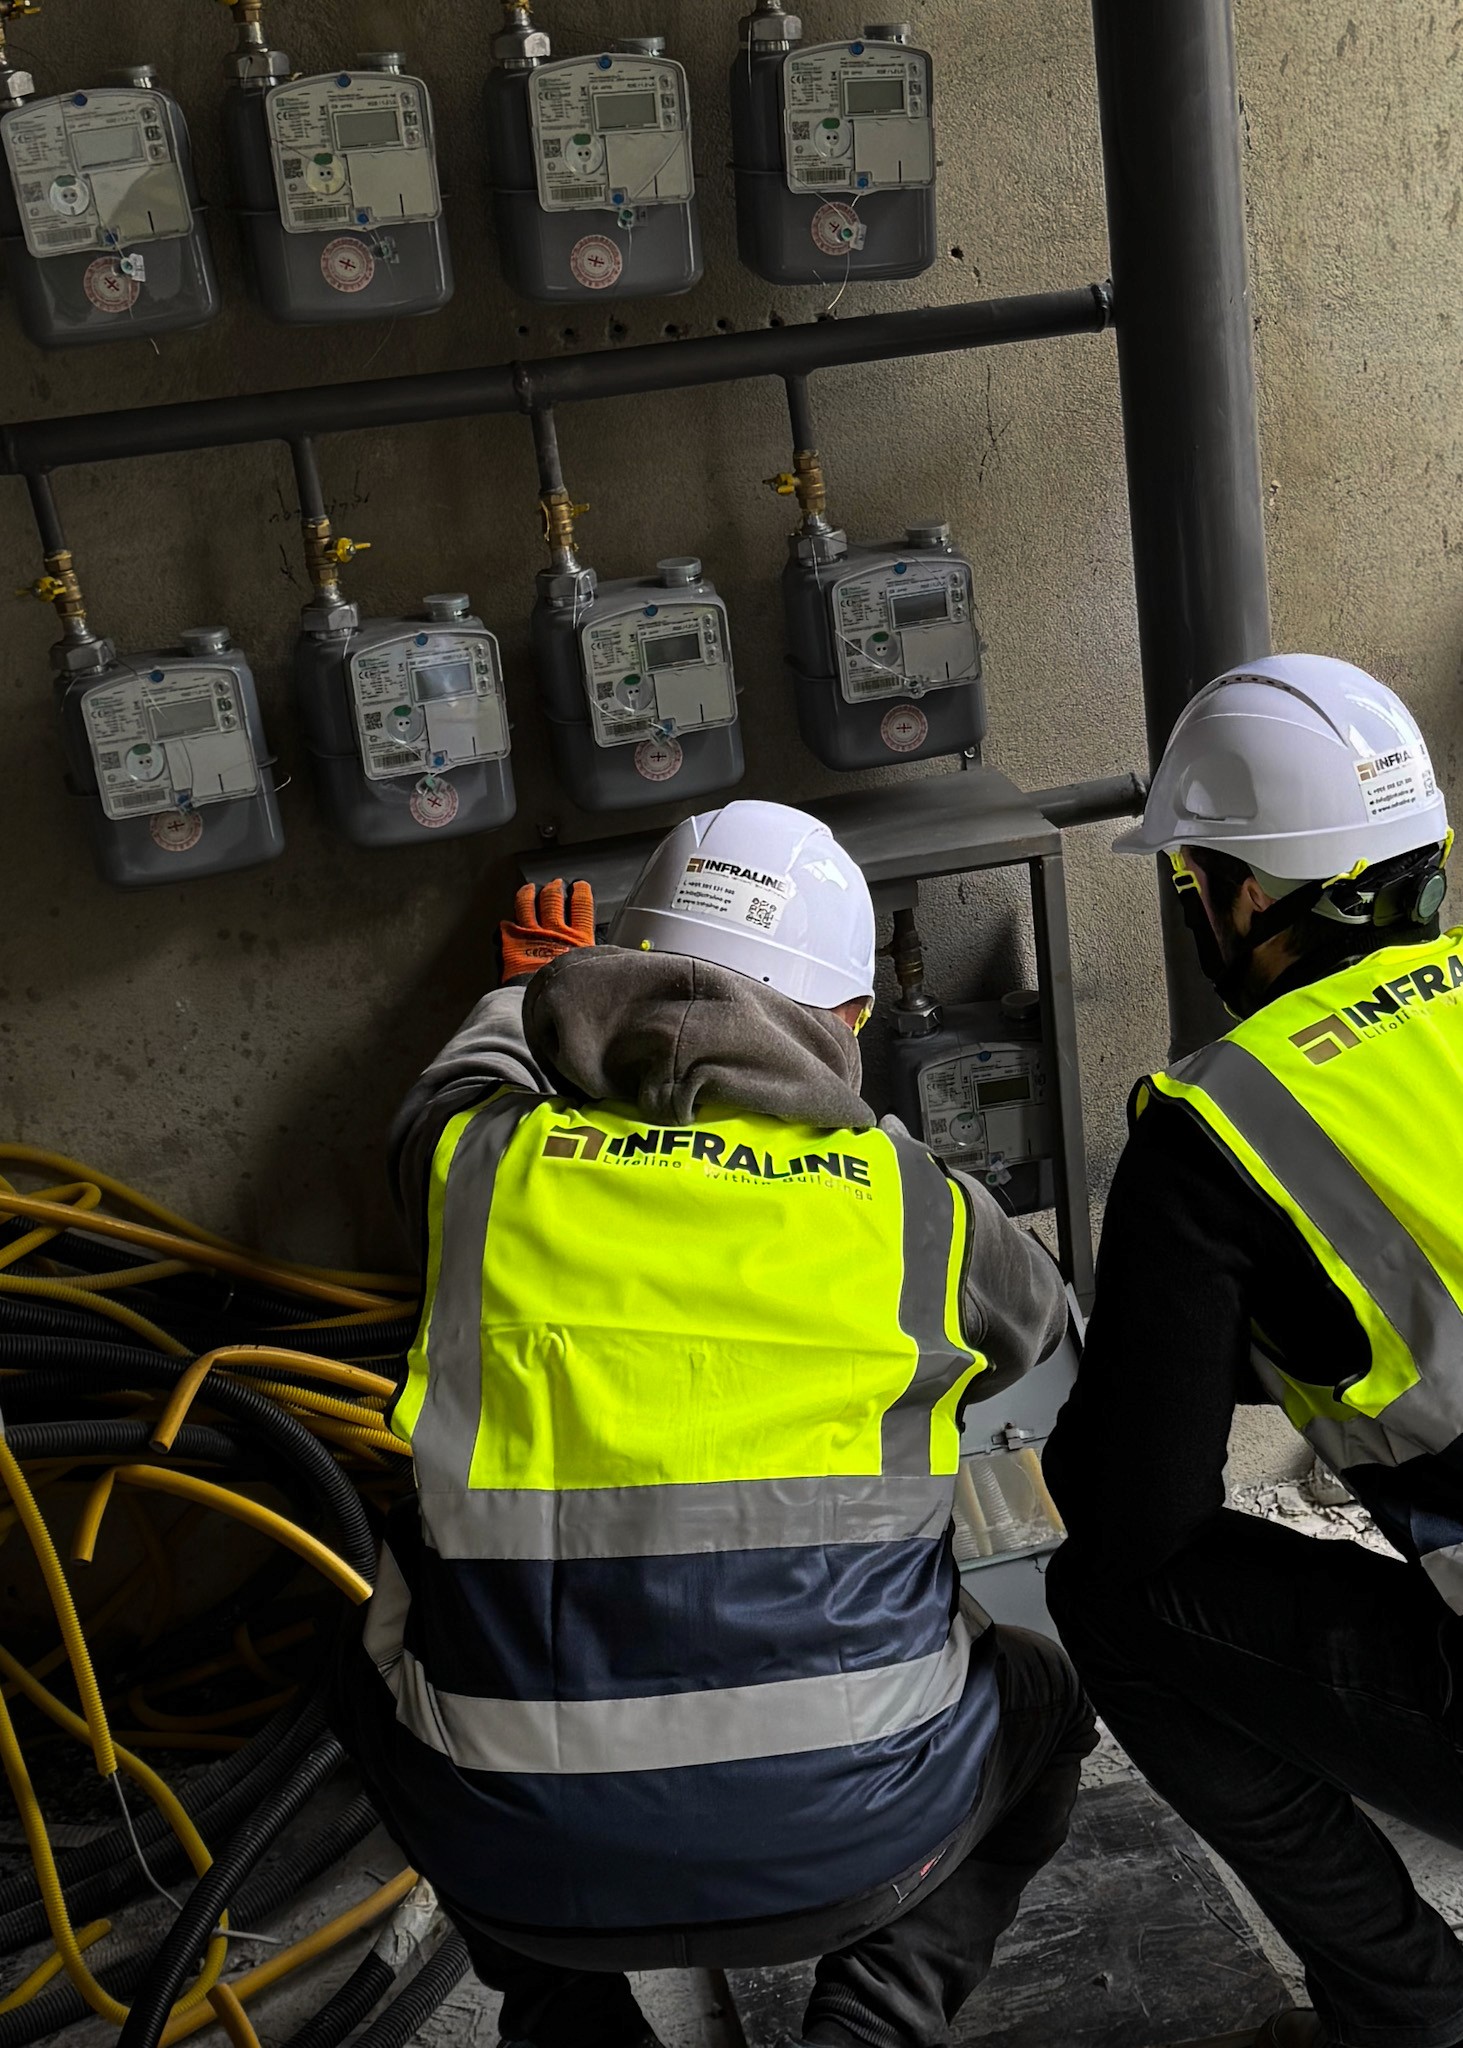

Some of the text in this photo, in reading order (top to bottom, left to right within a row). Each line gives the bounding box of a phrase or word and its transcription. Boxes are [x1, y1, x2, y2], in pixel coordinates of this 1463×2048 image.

[704, 860, 785, 893] INFRALINE
[1341, 955, 1463, 1028] INFRA
[607, 1129, 871, 1187] INFRALINE
